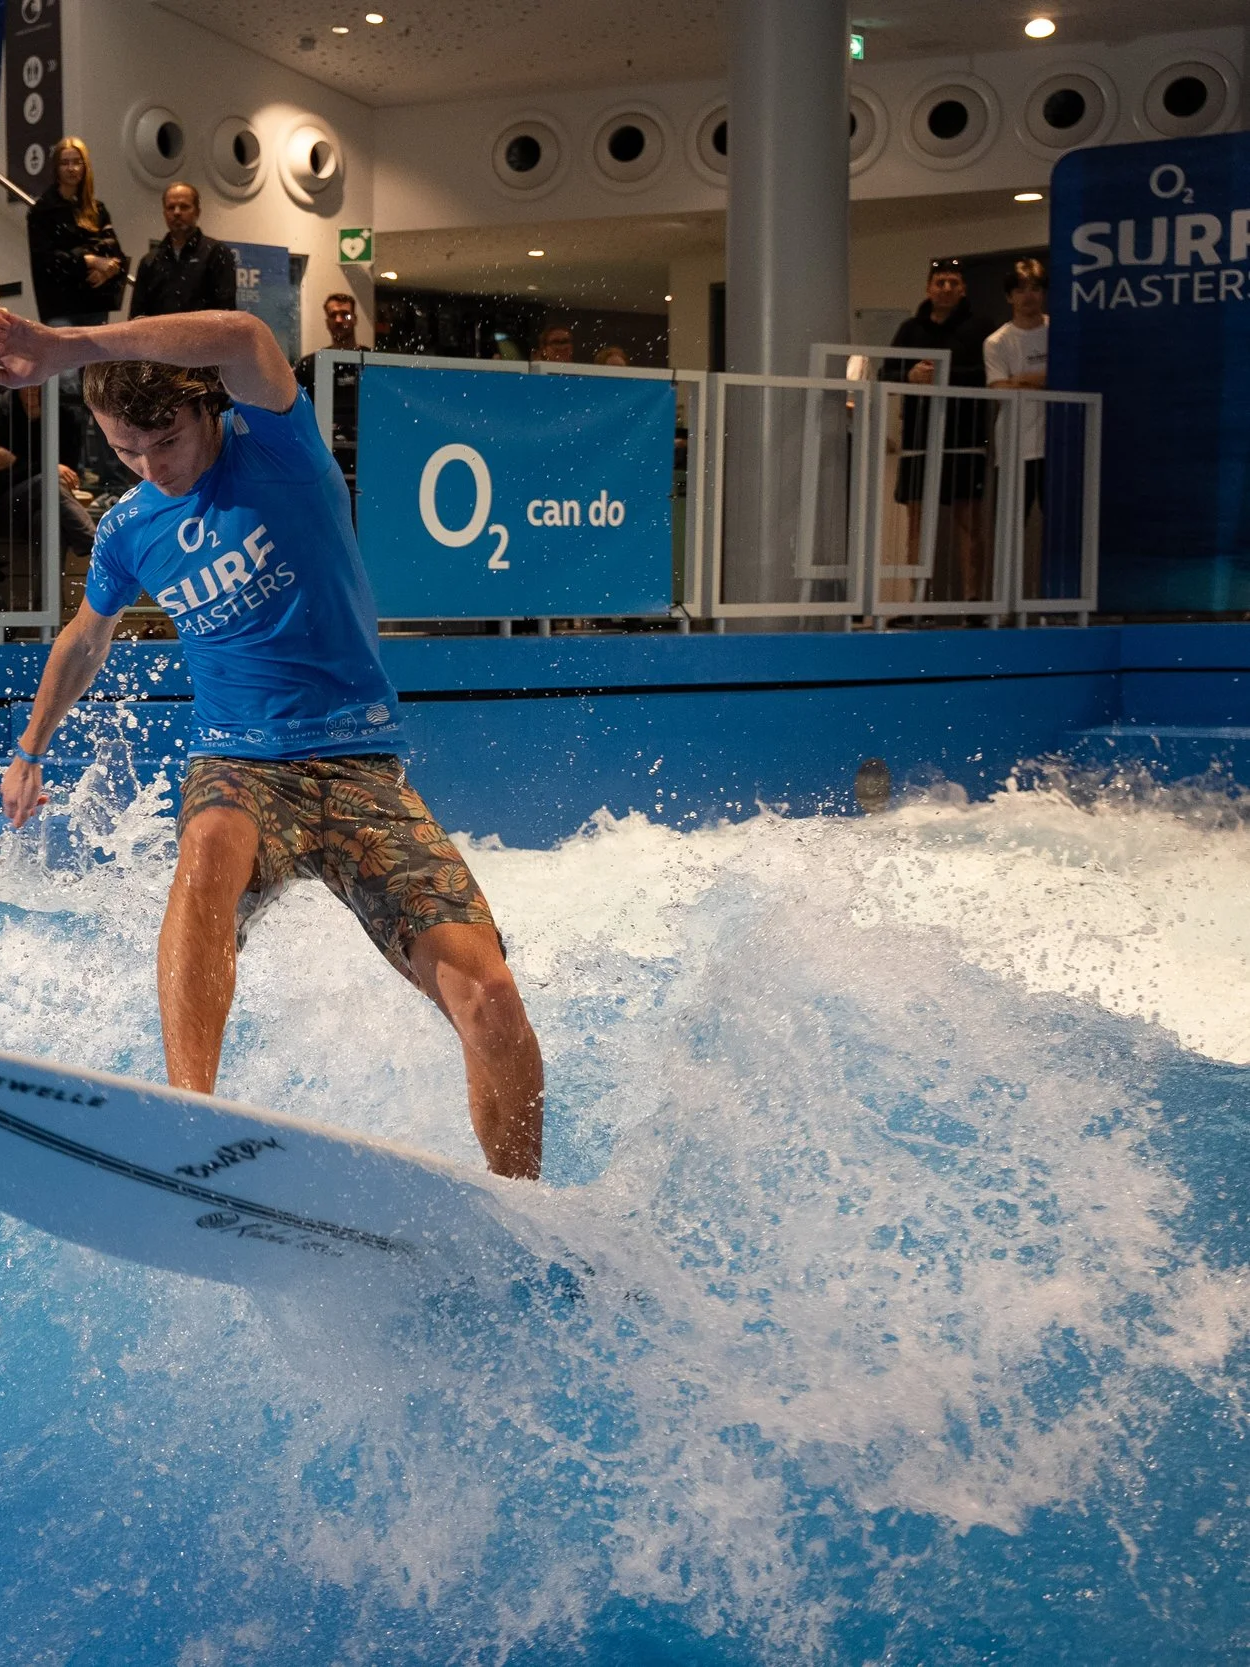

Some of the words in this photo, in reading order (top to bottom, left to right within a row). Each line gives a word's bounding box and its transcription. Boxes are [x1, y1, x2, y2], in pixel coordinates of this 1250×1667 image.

[236, 267, 261, 288] RF
[1071, 268, 1250, 312] MASTER
[527, 499, 580, 527] can
[588, 489, 625, 527] do
[156, 523, 276, 618] SURF
[328, 717, 353, 730] SURF
